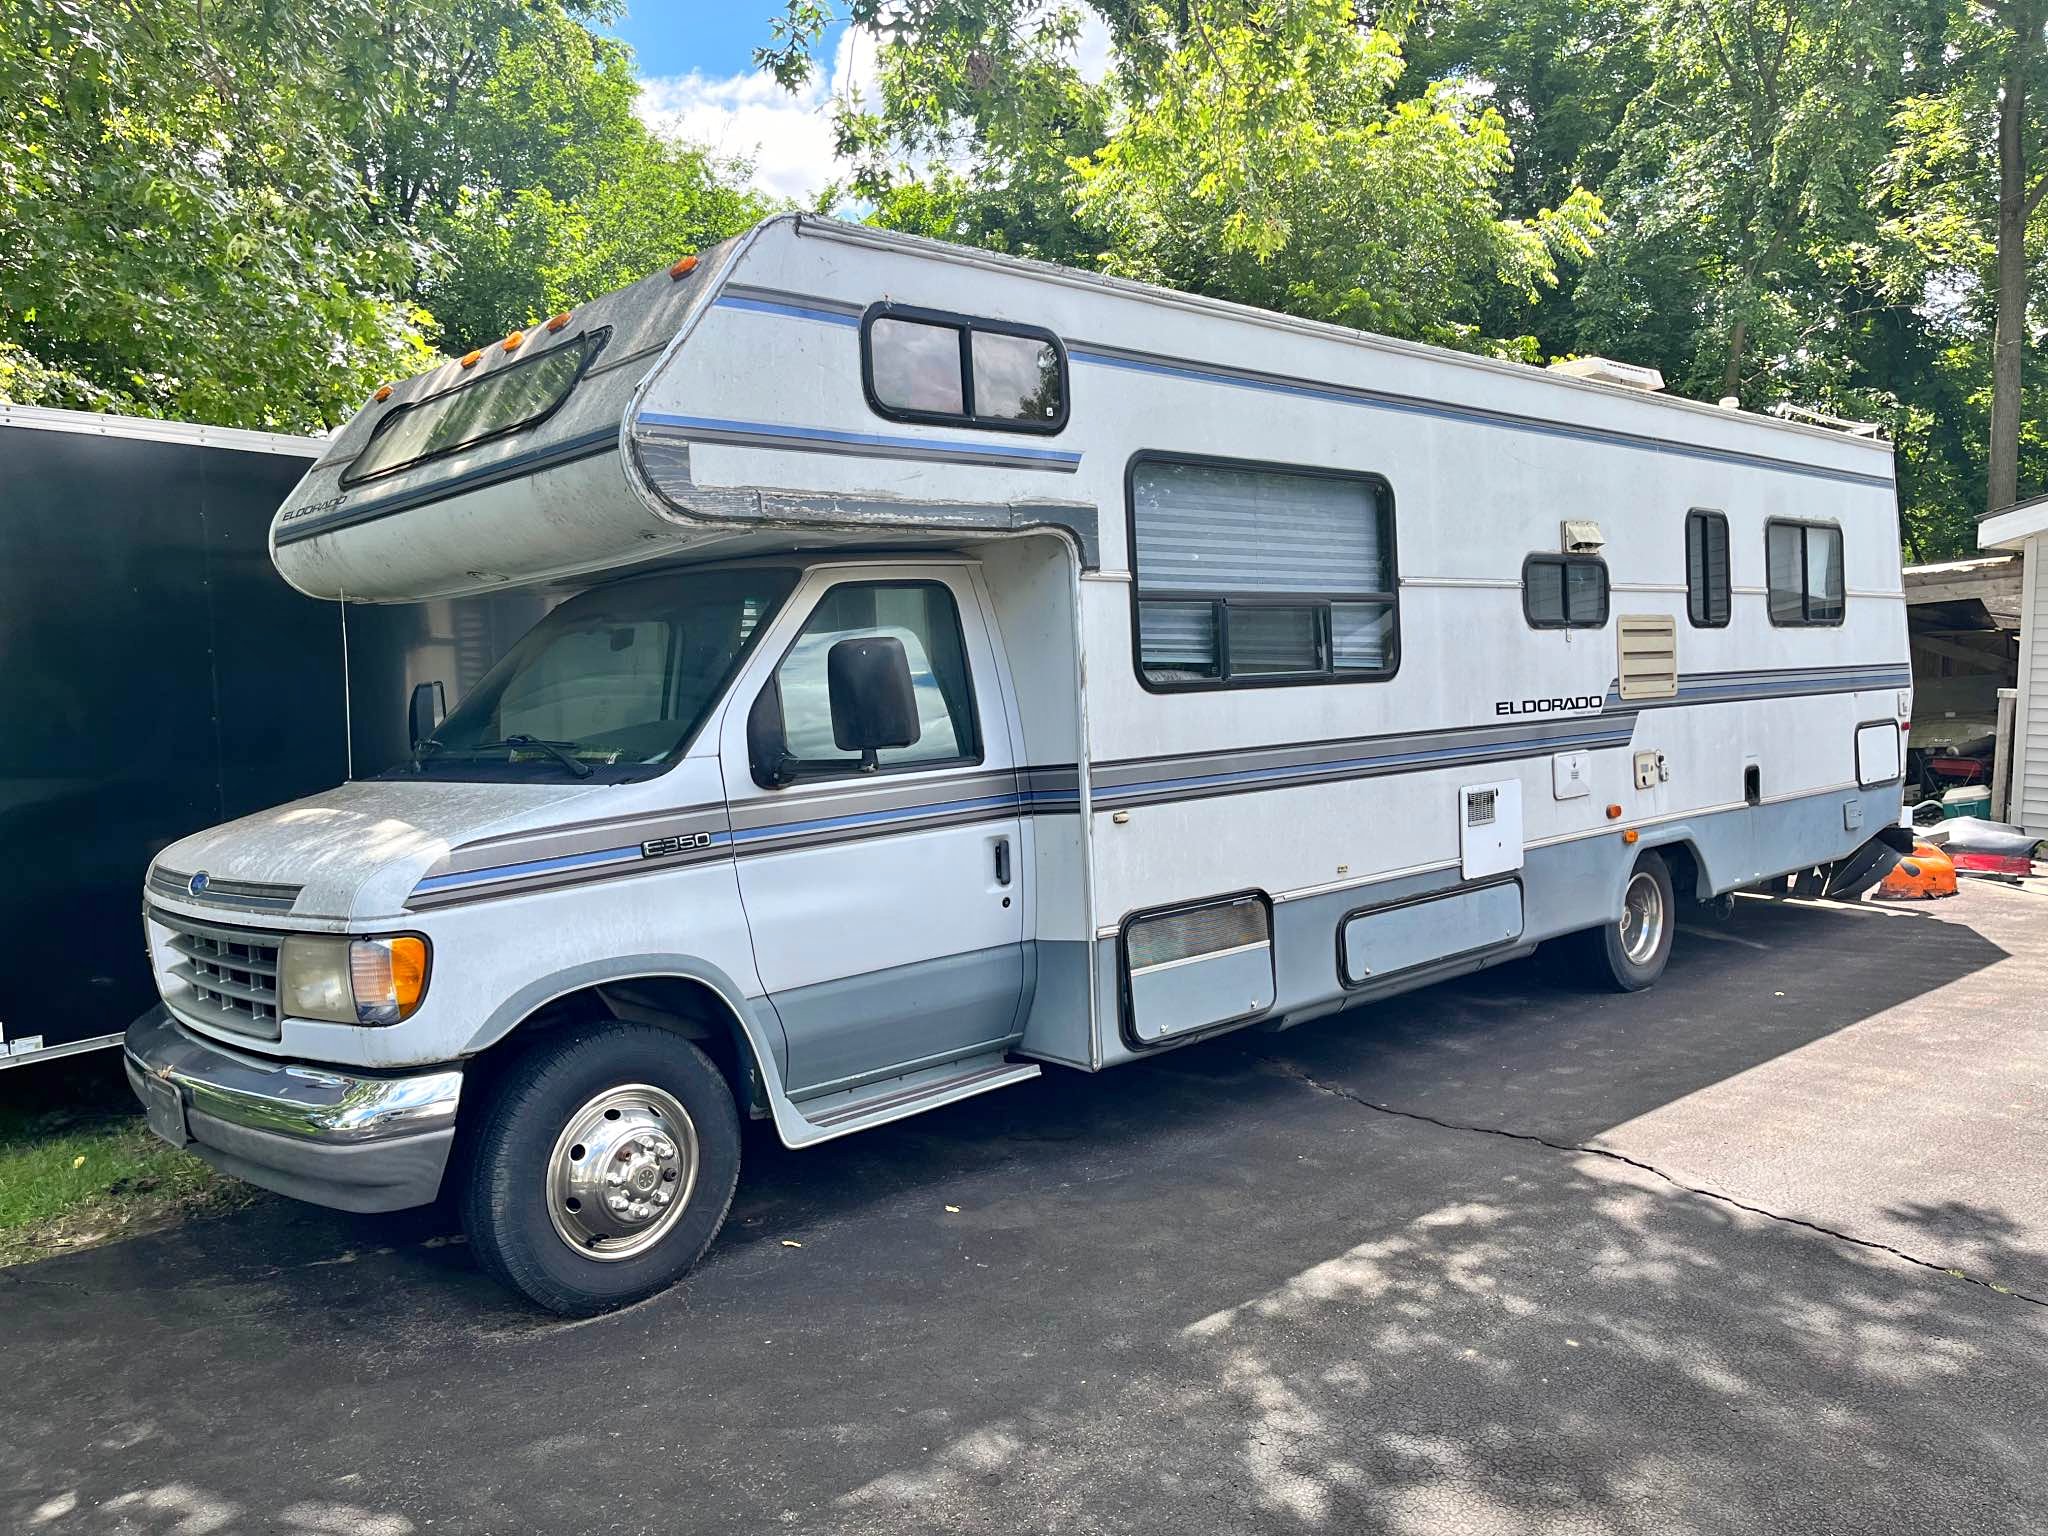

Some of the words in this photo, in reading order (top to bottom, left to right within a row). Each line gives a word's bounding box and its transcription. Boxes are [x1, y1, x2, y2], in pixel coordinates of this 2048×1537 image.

[283, 496, 347, 521] ELDORADO
[1496, 696, 1602, 715] ELDORADO
[642, 832, 710, 856] E350
